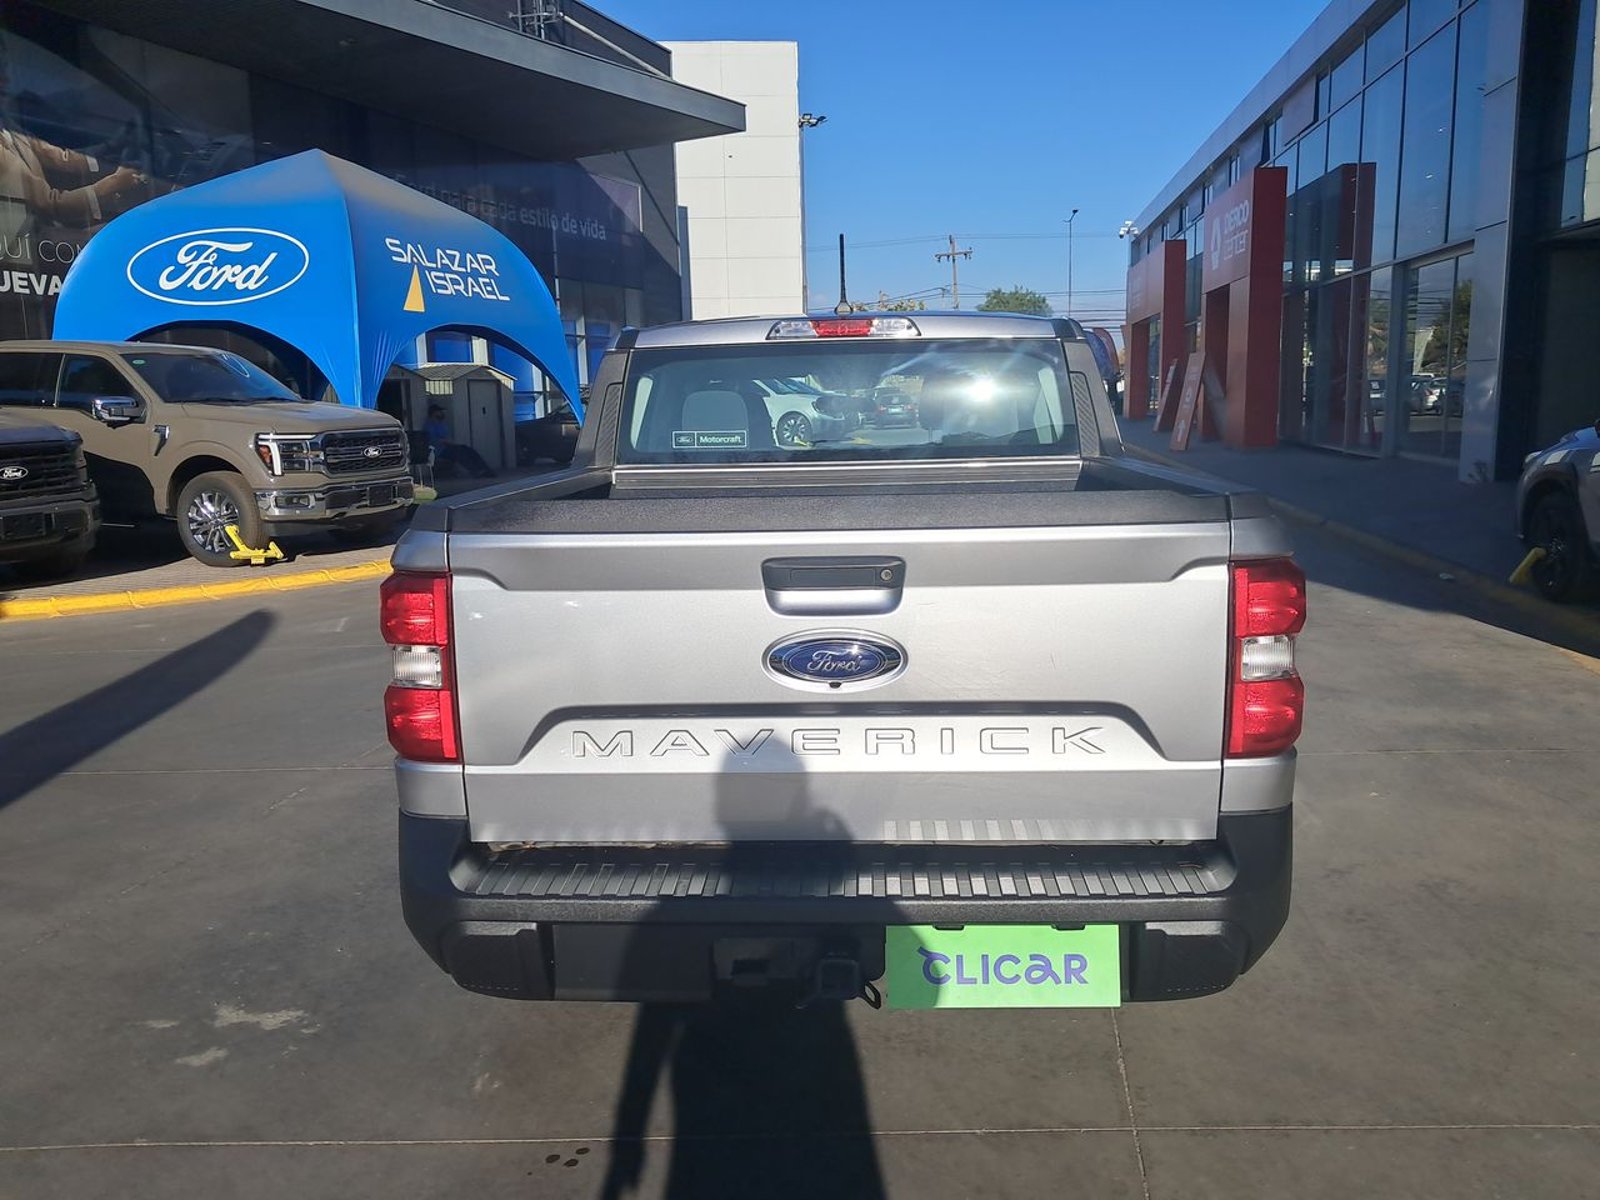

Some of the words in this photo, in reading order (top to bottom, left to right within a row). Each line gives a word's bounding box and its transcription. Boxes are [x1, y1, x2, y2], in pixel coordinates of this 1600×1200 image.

[519, 206, 559, 231] estilo
[561, 212, 578, 234] de
[579, 218, 606, 240] vida
[0, 232, 31, 260] UÍ
[385, 237, 500, 277] SALAZAR
[158, 239, 278, 291] Ford
[424, 269, 511, 301] ISRAEL
[699, 434, 743, 444] Motorcraft
[807, 647, 863, 673] Ford
[572, 726, 1106, 757] MAVERICK
